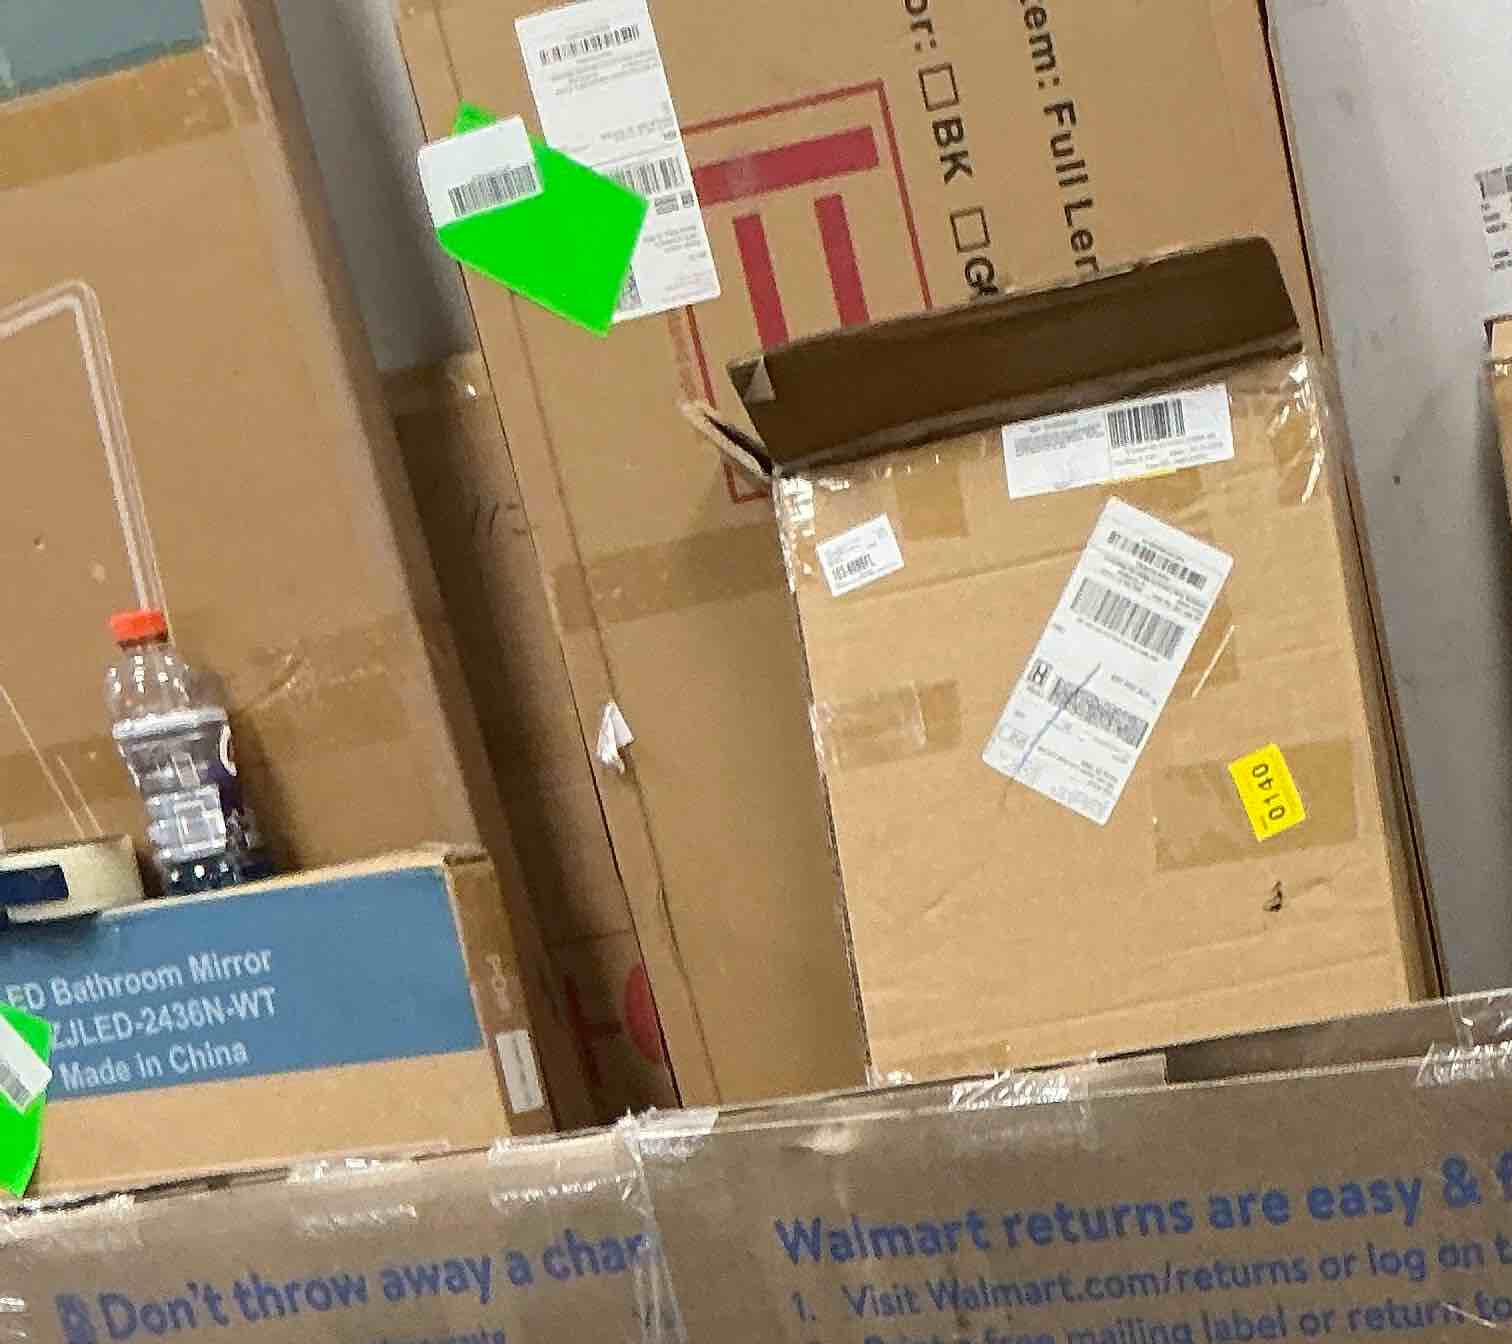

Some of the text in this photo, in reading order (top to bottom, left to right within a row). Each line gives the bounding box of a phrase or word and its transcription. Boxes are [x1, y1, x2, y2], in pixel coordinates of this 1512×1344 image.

[1020, 0, 1060, 90] em:
[1043, 99, 1089, 188] Full
[932, 116, 974, 185] BK
[1252, 763, 1285, 820] 0140
[5, 950, 272, 1011] ED Bathroom Mirror
[58, 1056, 131, 1091] Made
[168, 1040, 249, 1074] China
[774, 1210, 990, 1264] Walmart
[1002, 1197, 1194, 1248] returns
[1207, 1186, 1291, 1229] are
[1305, 1177, 1423, 1227] easy
[1440, 1155, 1481, 1209] &
[232, 1267, 369, 1323] throw
[382, 1255, 493, 1305] away
[506, 1250, 534, 1287] a
[792, 1291, 817, 1321] 1.
[842, 1281, 921, 1318] Visit
[926, 1256, 1308, 1313] Walmart.com/returns
[1319, 1251, 1358, 1281] or
[1367, 1242, 1427, 1281] log
[1437, 1242, 1484, 1270] on
[1202, 1304, 1288, 1344] label
[1299, 1308, 1336, 1337] or
[1347, 1298, 1466, 1333] return
